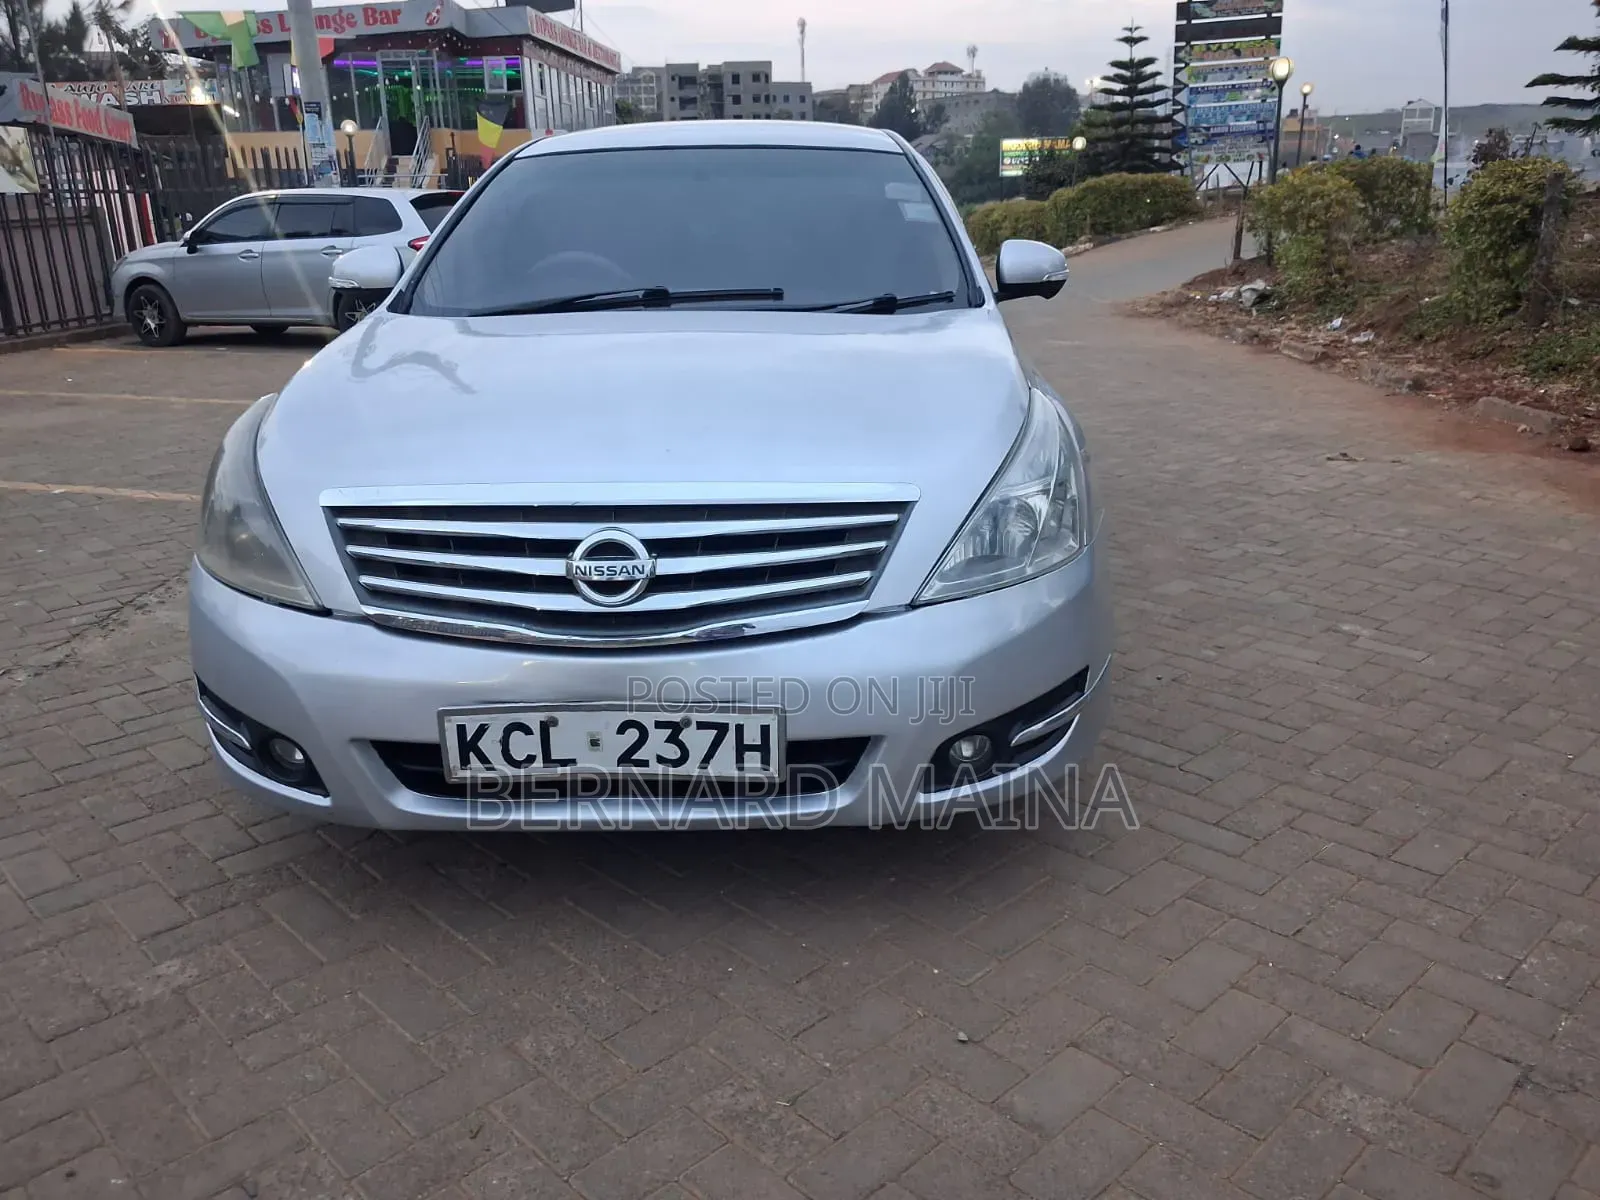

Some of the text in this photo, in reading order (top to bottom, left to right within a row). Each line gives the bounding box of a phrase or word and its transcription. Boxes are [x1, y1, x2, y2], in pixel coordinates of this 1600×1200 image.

[362, 7, 401, 26] Bar
[574, 564, 646, 577] NISSAN
[455, 718, 771, 772] KCL 237H
